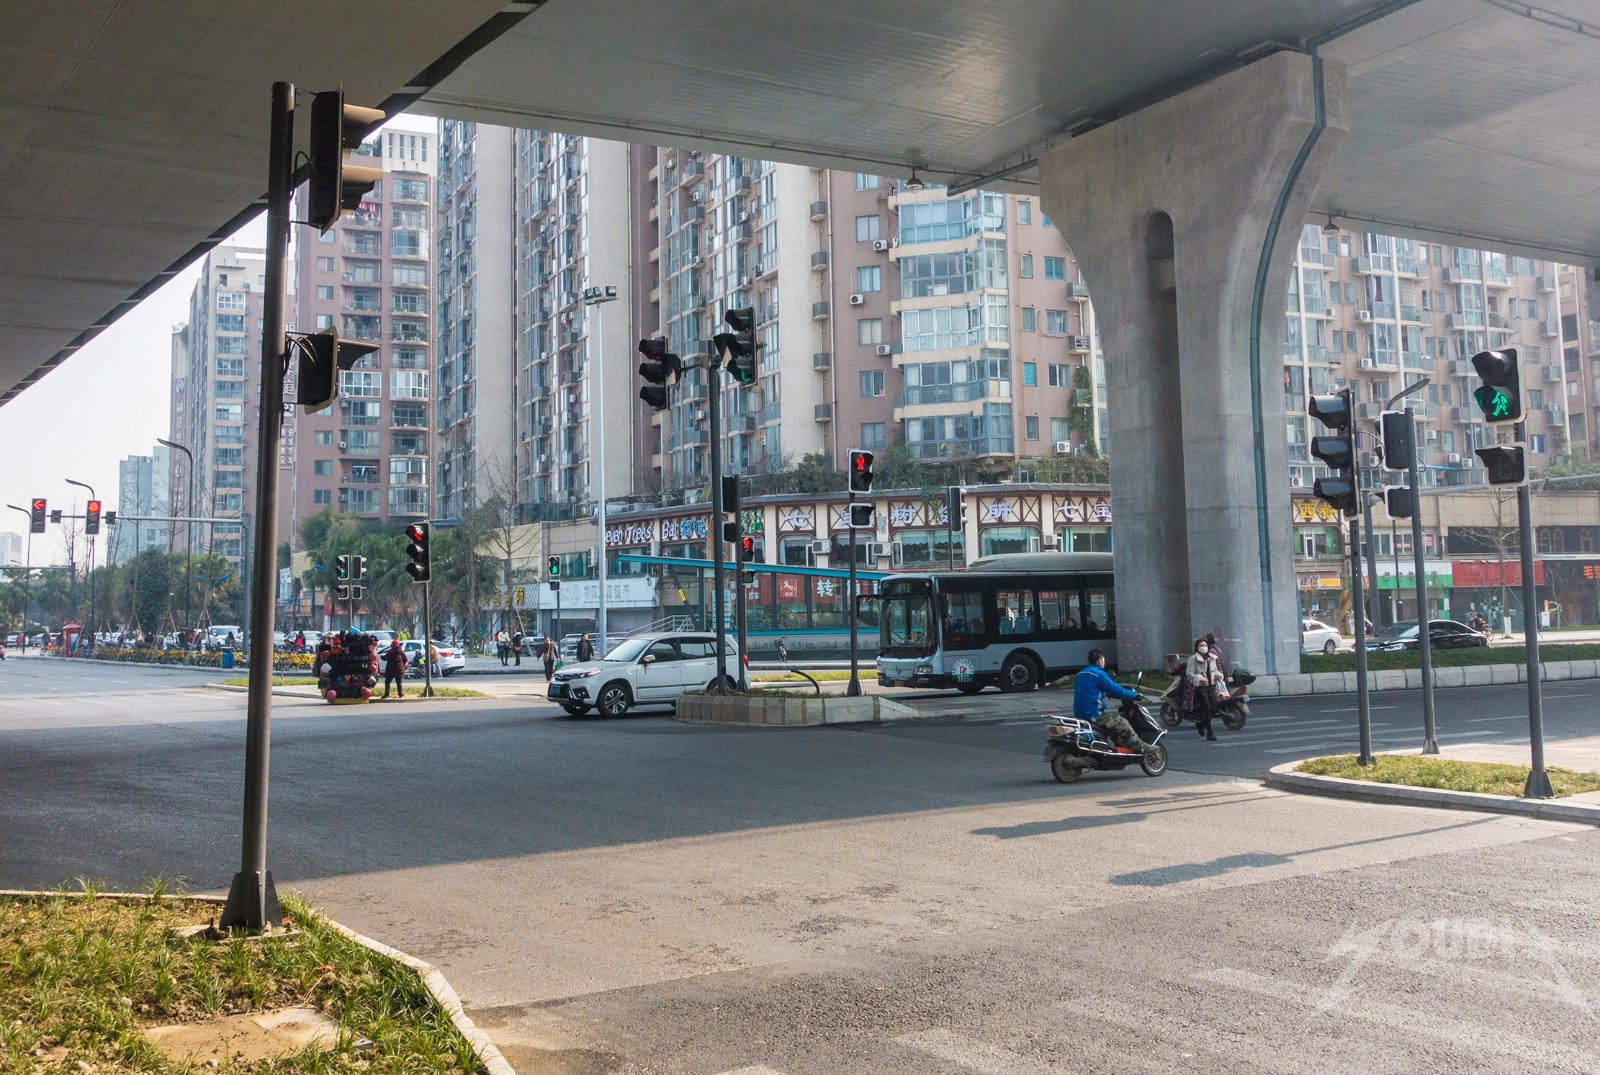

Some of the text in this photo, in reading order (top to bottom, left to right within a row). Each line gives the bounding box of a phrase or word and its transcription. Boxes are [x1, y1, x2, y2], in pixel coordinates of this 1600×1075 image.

[605, 518, 708, 543] even Trees Bar 酒吧
[584, 584, 629, 600] 中国商银行
